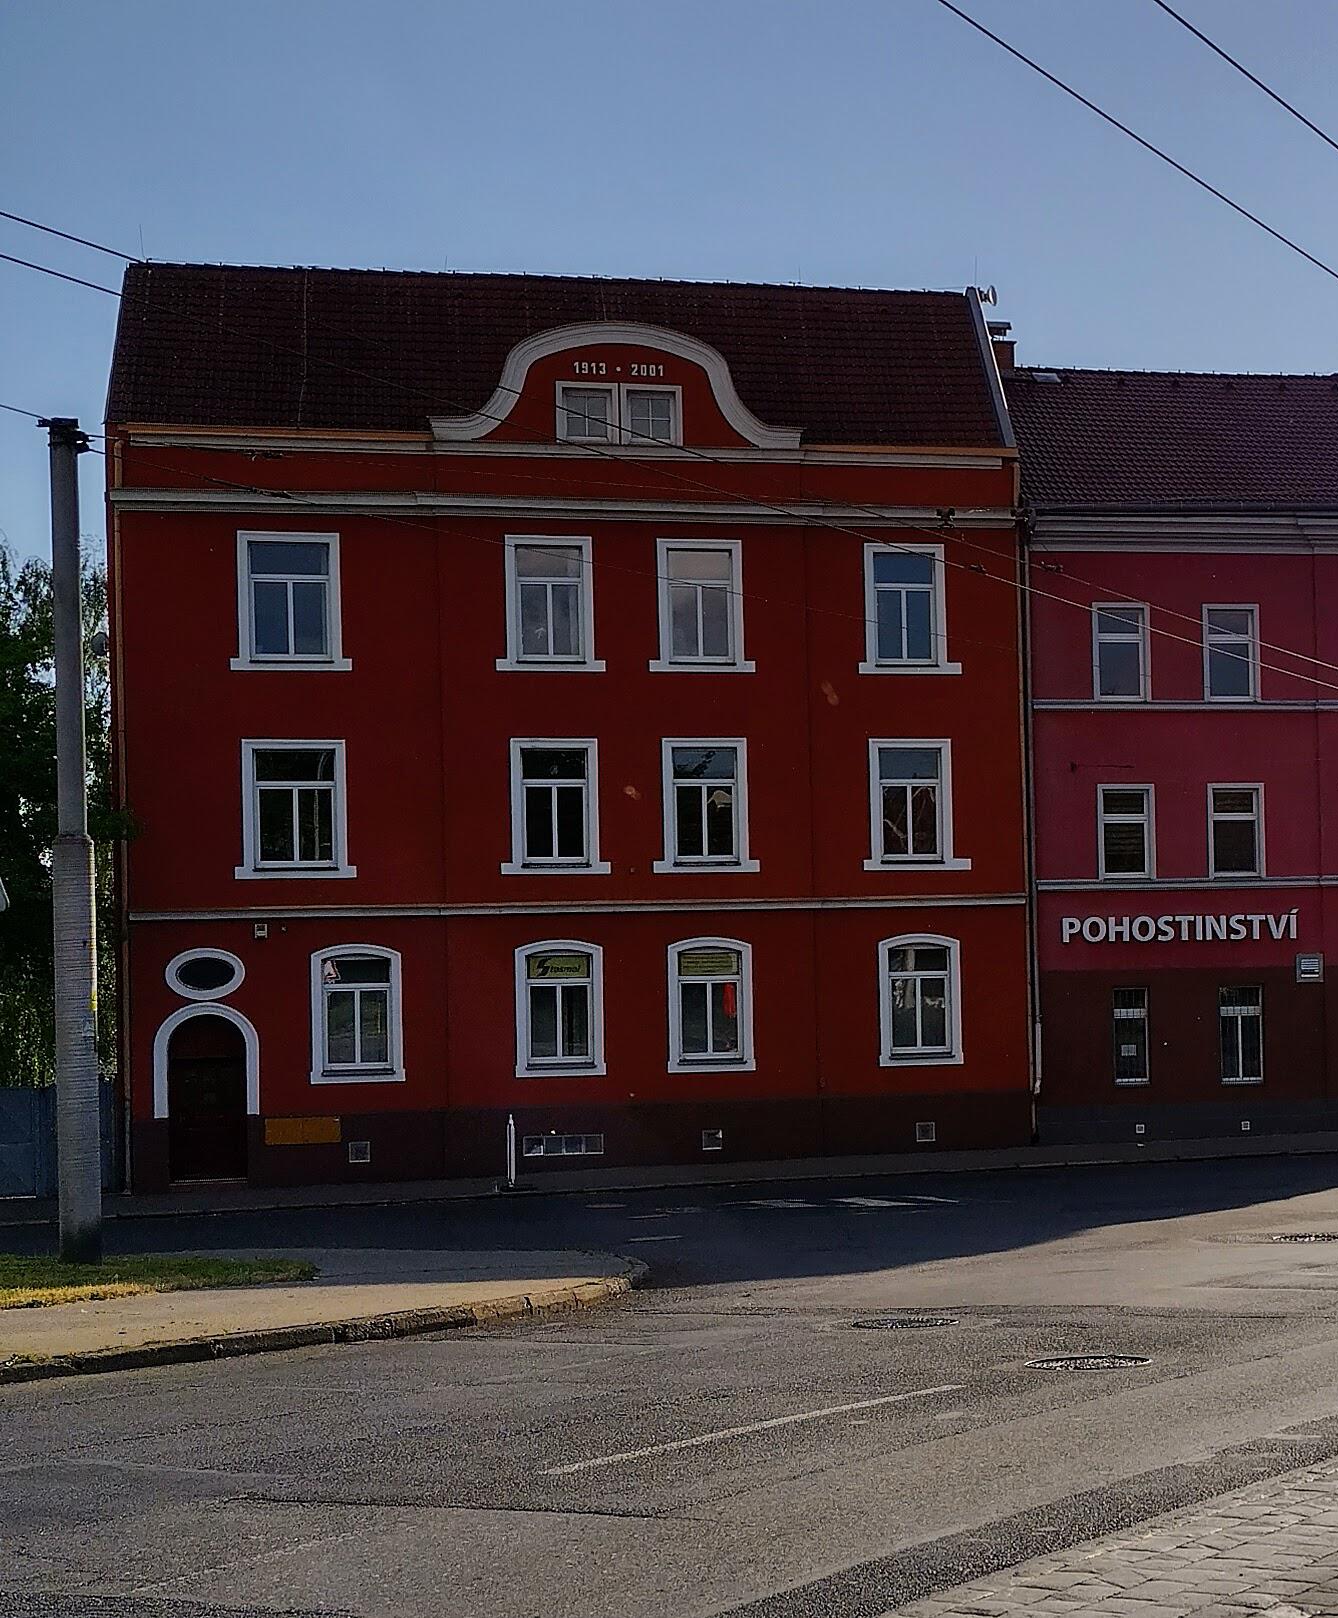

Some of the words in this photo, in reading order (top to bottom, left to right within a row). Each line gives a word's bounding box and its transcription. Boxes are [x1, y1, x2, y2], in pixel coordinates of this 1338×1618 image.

[573, 361, 607, 375] 1913
[631, 363, 664, 377] 2001
[1061, 908, 1300, 943] POHOSTINSTVÍ
